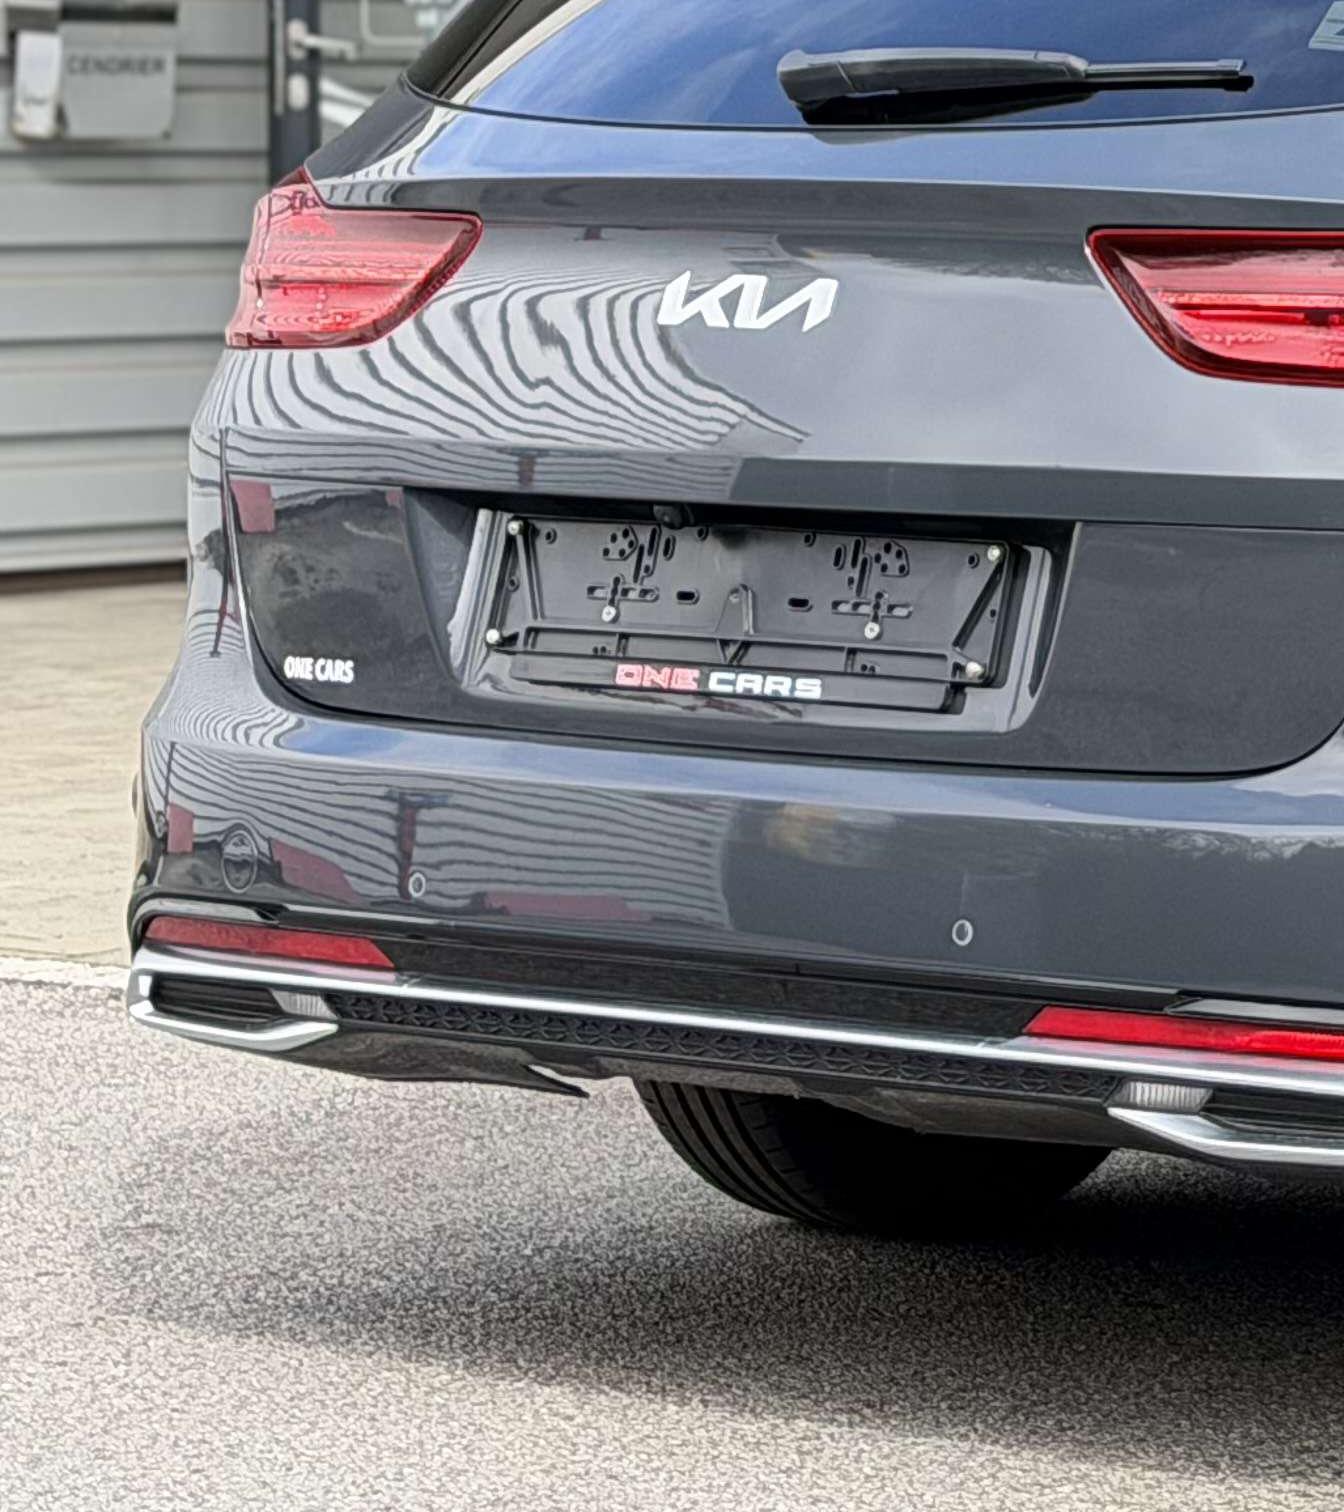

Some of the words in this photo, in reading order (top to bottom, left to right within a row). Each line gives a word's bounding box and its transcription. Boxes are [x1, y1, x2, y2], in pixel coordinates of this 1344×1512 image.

[66, 55, 166, 76] CENDRIER
[656, 270, 839, 333] KIA
[283, 655, 314, 681] ONE
[314, 657, 355, 684] CARS
[615, 664, 700, 693] ONE
[708, 671, 822, 699] CARS
